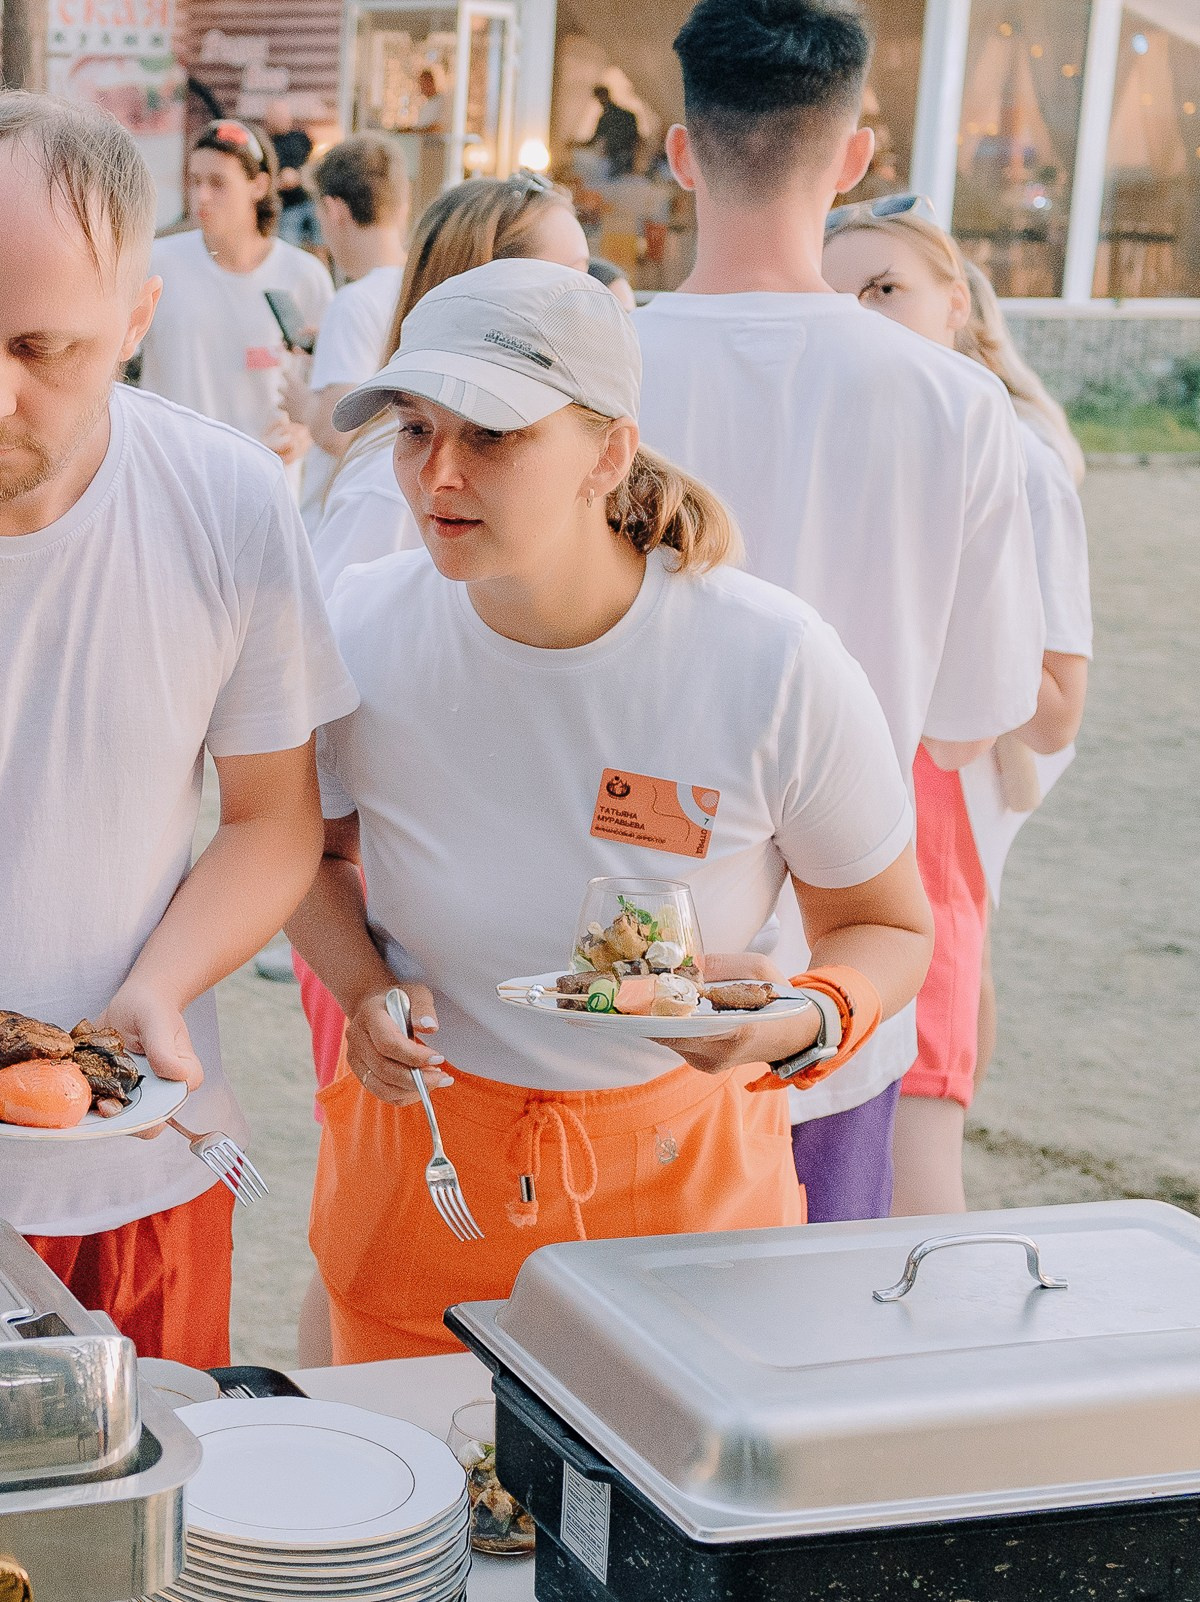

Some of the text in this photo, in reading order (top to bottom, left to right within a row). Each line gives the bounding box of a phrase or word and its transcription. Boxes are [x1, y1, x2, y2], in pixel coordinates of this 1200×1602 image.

[599, 805, 638, 820] ТАТЬЯНА
[597, 815, 645, 830] МУРАВЬЕВА
[703, 817, 710, 825] 7
